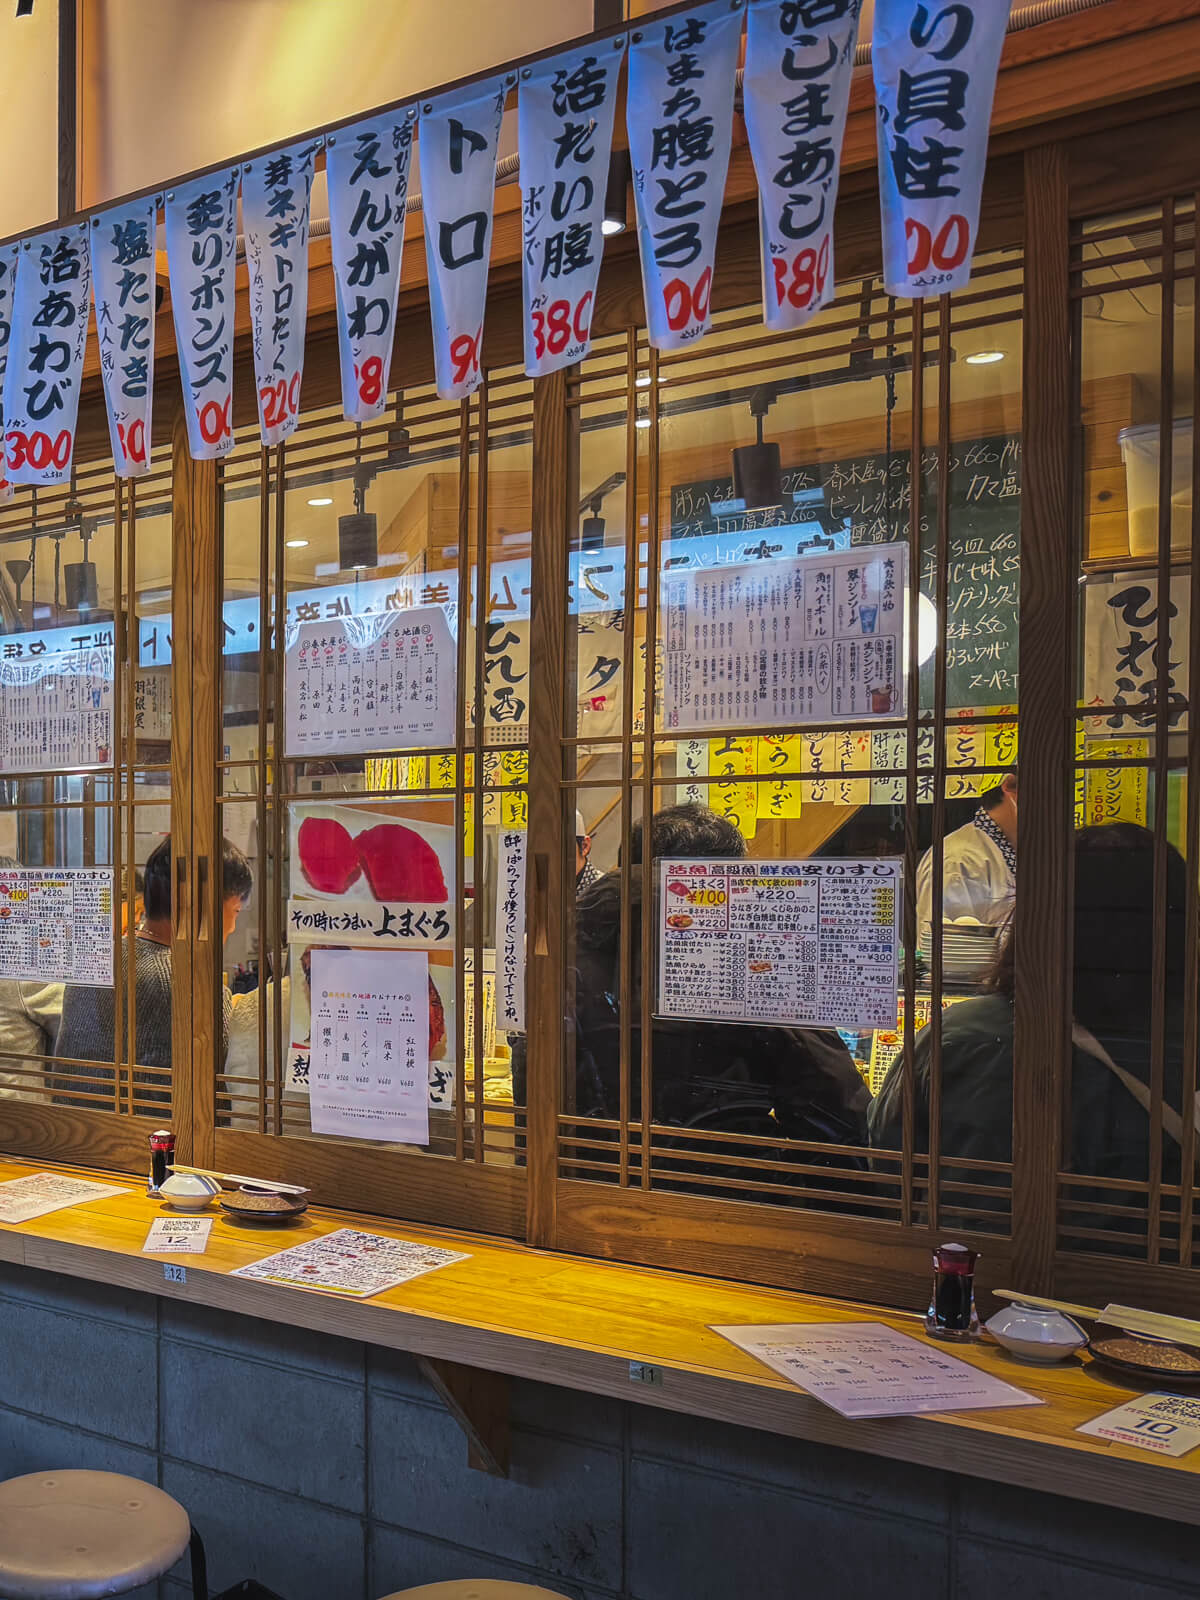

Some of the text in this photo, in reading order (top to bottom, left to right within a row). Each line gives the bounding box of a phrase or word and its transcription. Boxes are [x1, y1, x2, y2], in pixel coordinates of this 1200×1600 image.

[650, 18, 715, 269] はまち腹とろ
[541, 57, 607, 283] 活たい腹
[439, 118, 489, 270] トロ
[349, 132, 393, 339] えんがわ
[264, 155, 299, 372] 芽ネギトロたく
[111, 219, 152, 398] 塩たたき
[23, 235, 81, 420] 活あわび
[5, 430, 71, 471] 300
[819, 651, 828, 686] お茶ハイ
[8, 890, 28, 900] ¥100
[42, 889, 63, 897] ¥220
[687, 890, 726, 904] ¥100
[689, 879, 726, 889] 上まぐろ
[755, 890, 796, 900] ¥220
[291, 905, 451, 941] その時にうまい 上まぐろ
[699, 919, 726, 928] ¥220
[384, 1040, 392, 1061] 雁木
[406, 1036, 416, 1069] 紅桔梗
[164, 1235, 190, 1244] 12
[169, 1267, 182, 1281] 12
[638, 1365, 656, 1382] 11
[1134, 1418, 1179, 1435] 10
